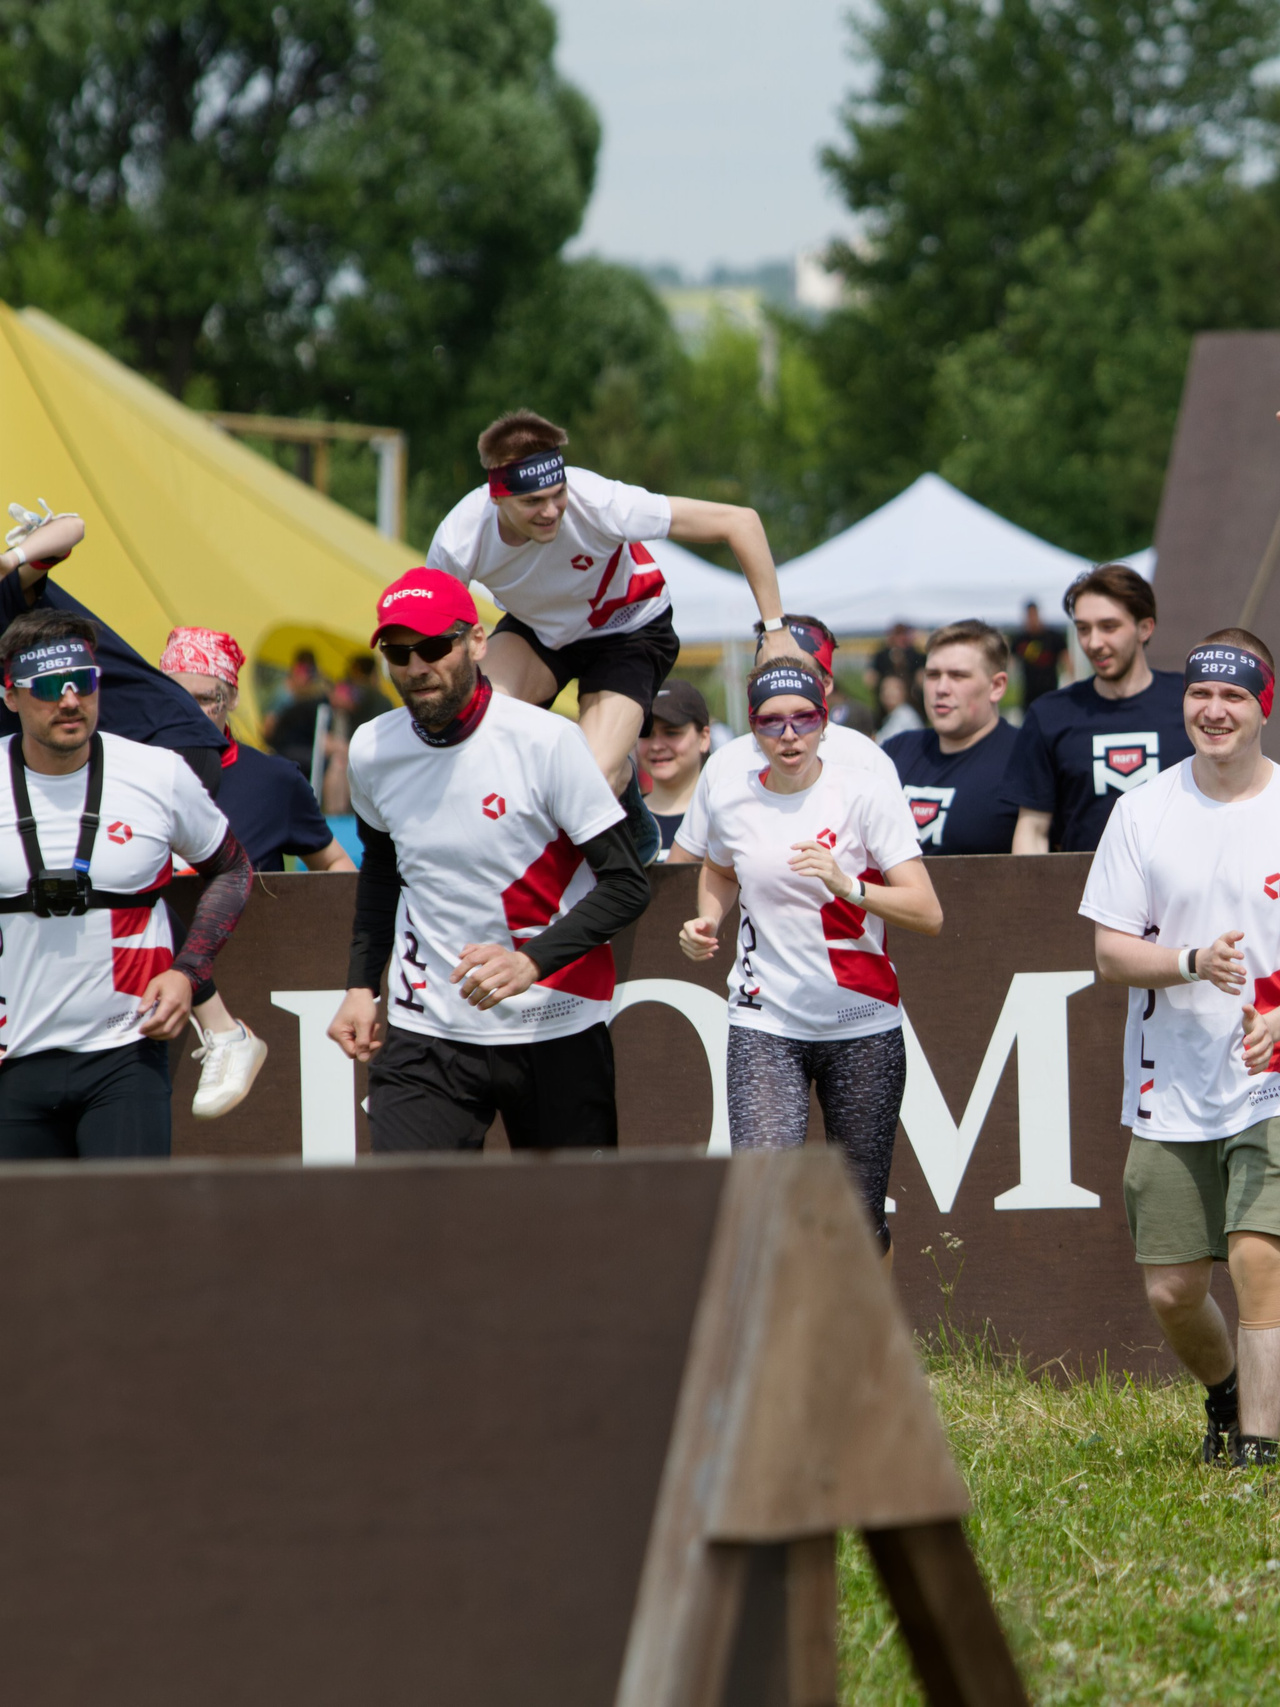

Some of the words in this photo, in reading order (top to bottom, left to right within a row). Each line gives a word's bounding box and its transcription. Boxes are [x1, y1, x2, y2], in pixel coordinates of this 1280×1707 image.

[519, 458, 558, 479] РОДЕО
[538, 469, 564, 487] 2877
[393, 588, 433, 600] КРОН
[19, 644, 67, 663] РОДЕО
[69, 643, 85, 652] 59
[1189, 650, 1236, 664] РОДЕО
[1240, 655, 1256, 668] 59
[37, 657, 73, 672] 2867
[1201, 663, 1237, 676] 2873
[757, 669, 798, 686] РОДЕО
[770, 679, 802, 690] 2888
